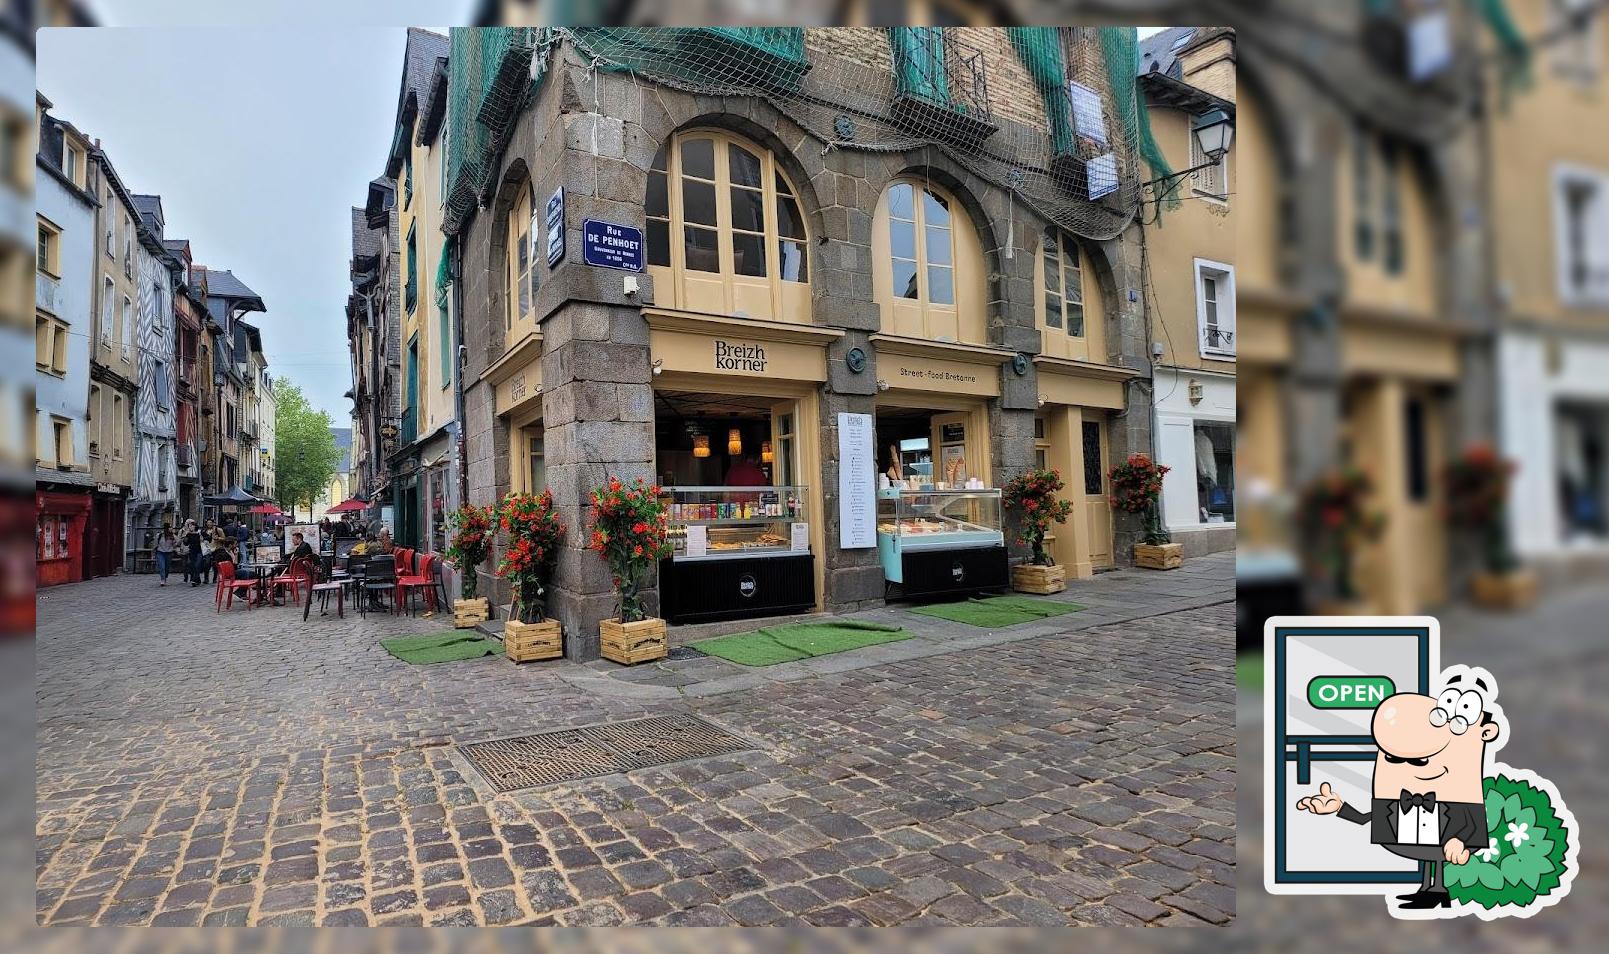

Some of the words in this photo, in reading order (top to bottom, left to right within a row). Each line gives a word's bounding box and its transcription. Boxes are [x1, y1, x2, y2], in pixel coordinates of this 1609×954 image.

[588, 233, 599, 243] DE
[602, 235, 639, 250] PENHOET
[715, 340, 766, 360] Breizh
[945, 372, 976, 383] Bretonne
